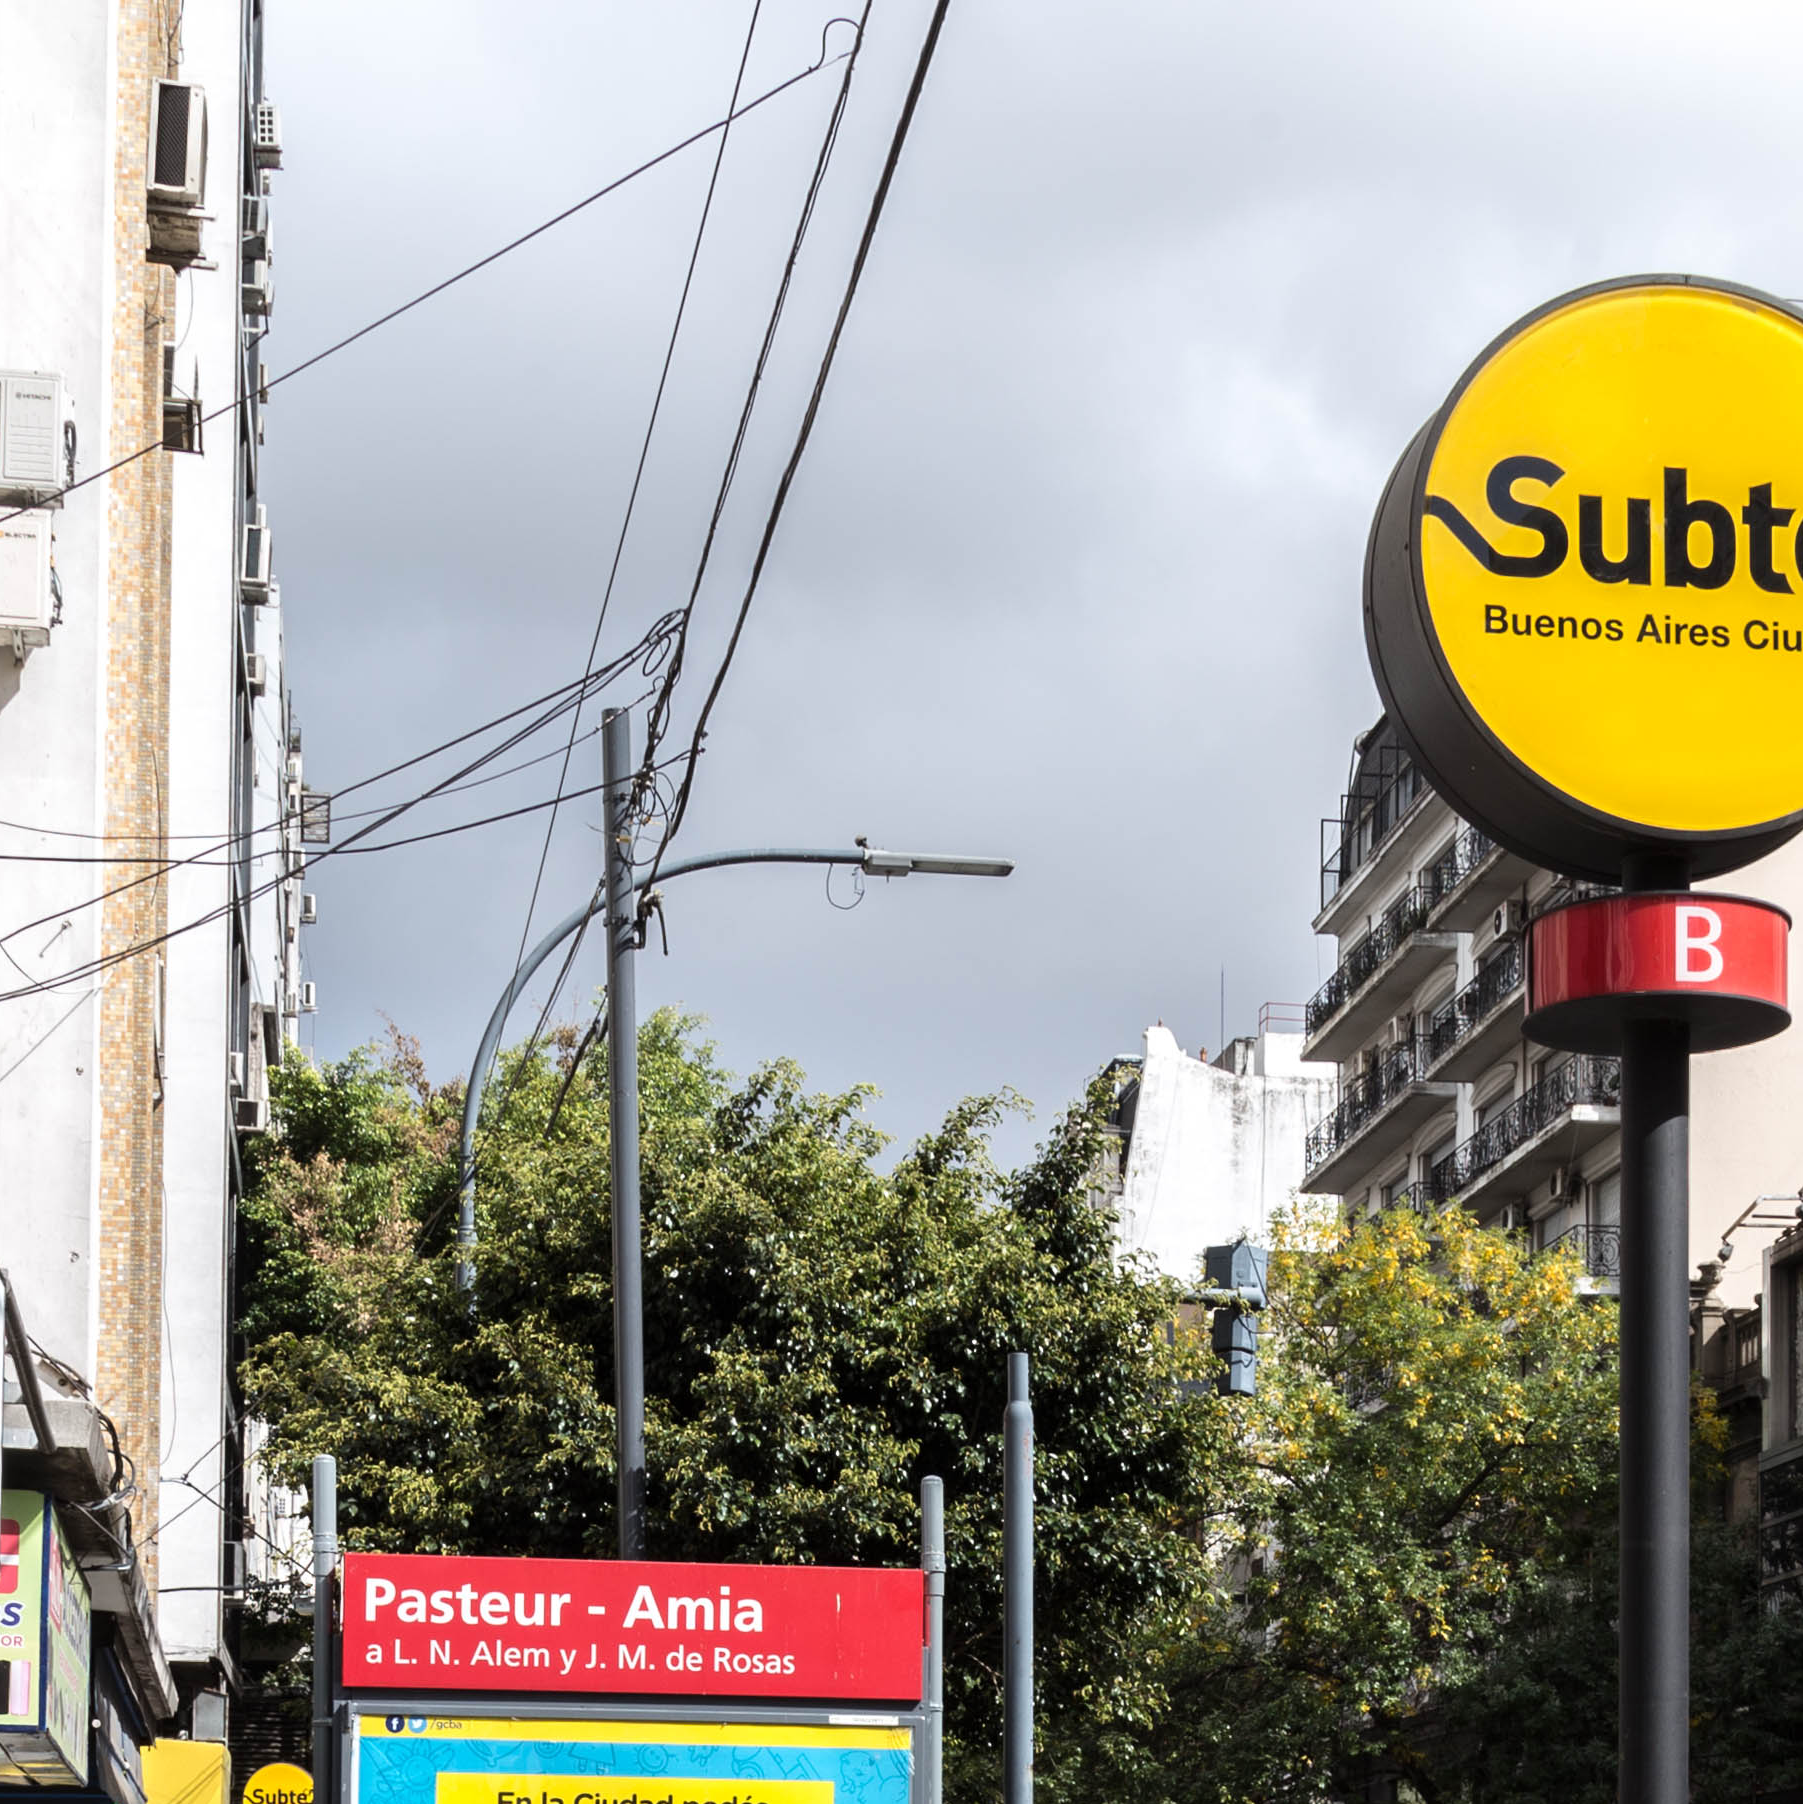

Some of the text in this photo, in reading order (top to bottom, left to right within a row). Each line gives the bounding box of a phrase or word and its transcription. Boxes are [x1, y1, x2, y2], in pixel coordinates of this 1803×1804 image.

[1483, 604, 1624, 643] Buenos
[1636, 613, 1730, 648] Aires
[1675, 905, 1724, 982] B
[364, 1577, 572, 1628] Pasteur
[622, 1584, 765, 1633] Amia
[365, 1640, 797, 1676] a L. N. Alem y J. M. de Rosas
